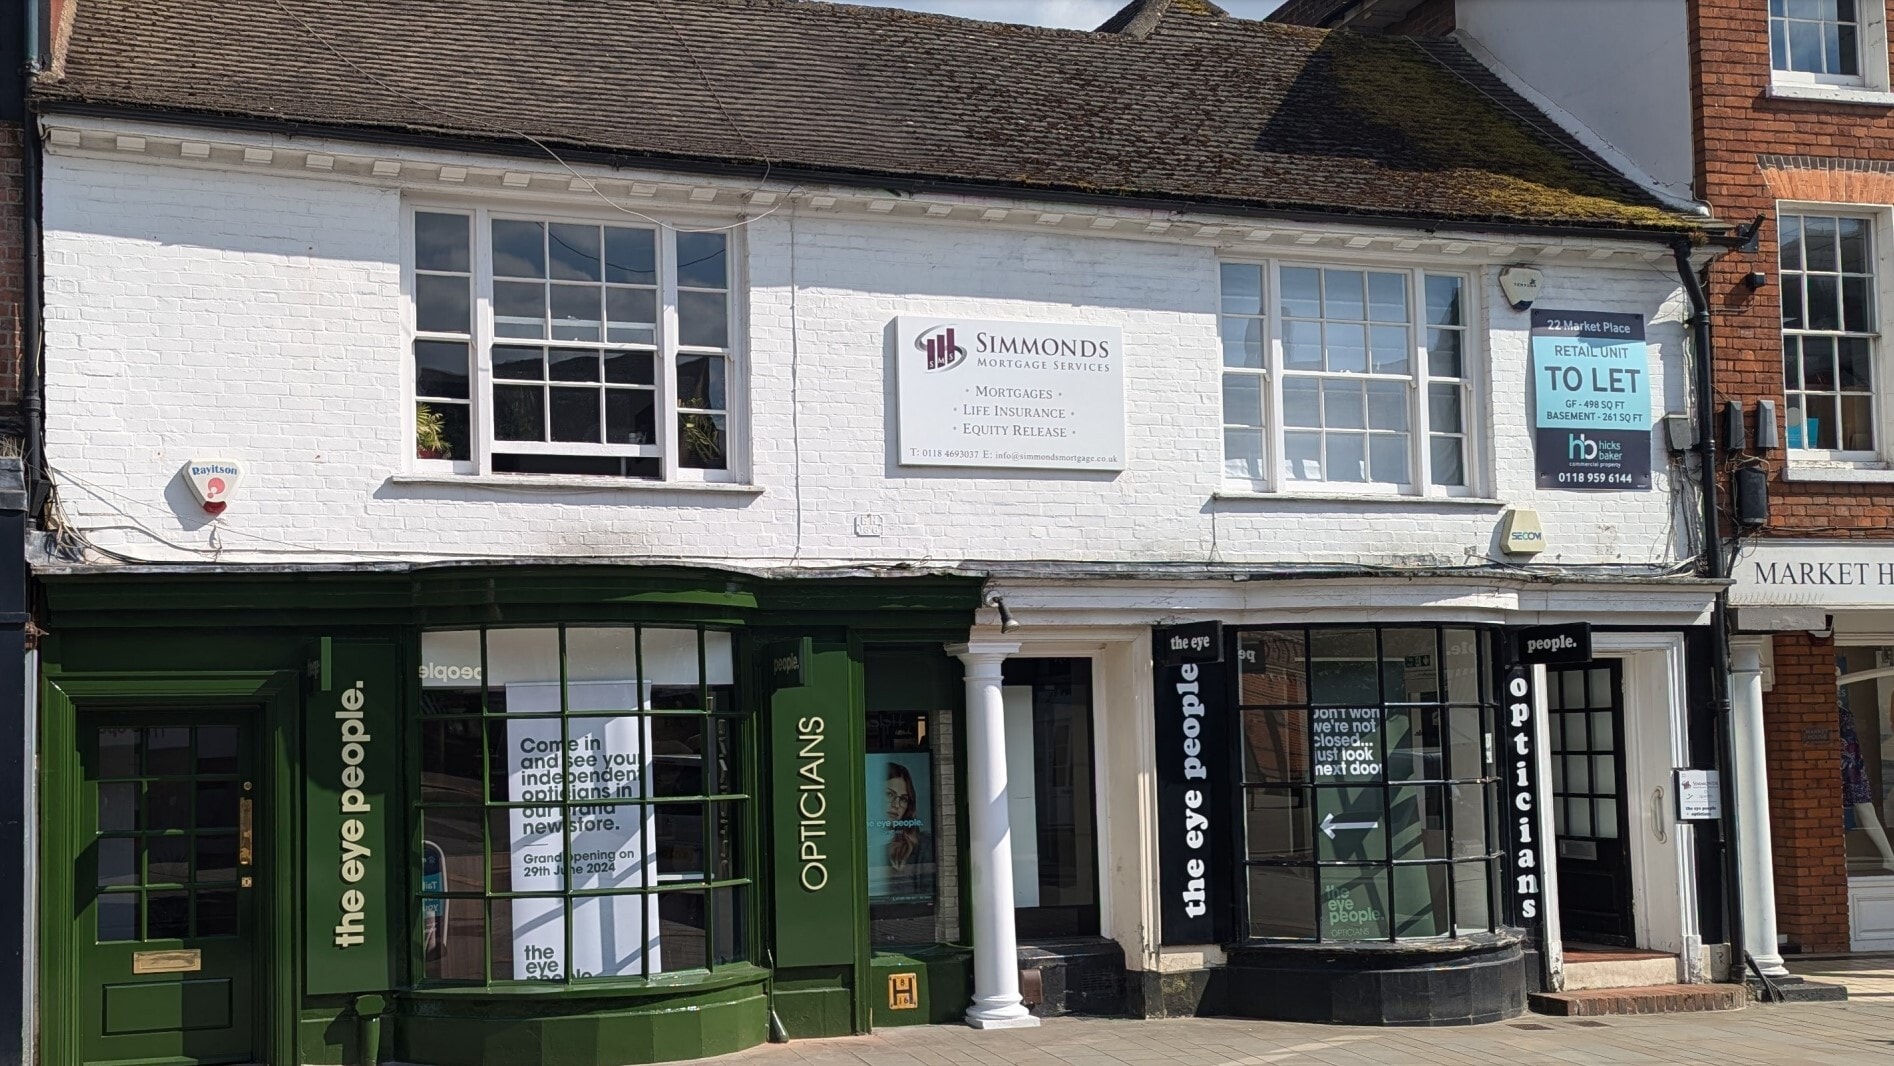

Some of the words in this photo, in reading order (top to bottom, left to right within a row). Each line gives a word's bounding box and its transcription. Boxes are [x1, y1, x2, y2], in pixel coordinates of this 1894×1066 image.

[1546, 319, 1561, 331] 22
[1563, 320, 1601, 332] Market
[1603, 321, 1631, 334] Place
[976, 332, 1109, 358] SIMMONDS
[1554, 345, 1598, 358] RETAIL
[1601, 346, 1628, 358] UNIT
[977, 358, 1047, 370] MORTGAGE
[1053, 360, 1110, 372] SERVICES
[1544, 366, 1583, 391] TO
[1591, 367, 1641, 393] LET
[975, 385, 1053, 399] MORTGAGES
[963, 404, 990, 416] LIFE
[994, 405, 1066, 418] INSURANCE
[1565, 400, 1577, 408] GF
[1583, 400, 1599, 409] 498
[1601, 401, 1613, 409] SQ
[1615, 401, 1625, 409] FT
[1546, 411, 1596, 420] BASEMENT
[1602, 412, 1617, 421] 261
[1619, 413, 1631, 422] SQ
[1632, 413, 1643, 422] FT
[962, 423, 1008, 436] EQUITY
[1013, 424, 1067, 438] RELEASE
[1599, 440, 1621, 450] hicks
[910, 447, 920, 457] T:
[922, 448, 942, 457] 0118
[944, 449, 979, 459] 4693037
[983, 449, 993, 459] E:
[1599, 451, 1622, 460] baker
[1558, 472, 1585, 483] 0118
[1587, 472, 1605, 483] 959
[1608, 473, 1632, 484] 6144
[1511, 531, 1542, 541] SECOM
[1754, 561, 1870, 585] MARKET
[1170, 635, 1188, 650] the
[1190, 636, 1210, 651] eye
[1527, 634, 1577, 653] people.
[1314, 719, 1349, 732] we're
[1353, 719, 1376, 732] not
[335, 680, 371, 812] people.
[520, 737, 579, 753] Come
[584, 735, 601, 751] in
[520, 753, 558, 770] and
[602, 753, 640, 769] you
[1342, 747, 1374, 761] look
[1315, 761, 1346, 776] next
[616, 783, 633, 798] in
[1509, 677, 1539, 918] opticians
[798, 716, 828, 890] OPTICIANS
[522, 807, 555, 818] our
[559, 805, 616, 817] rand
[523, 820, 563, 835] new
[568, 817, 620, 834] store.
[1184, 790, 1209, 849] eye
[341, 819, 371, 882] eye
[523, 851, 563, 864] Grand
[569, 849, 616, 865] pening
[619, 850, 634, 859] on
[523, 865, 551, 877] 29th
[586, 862, 616, 874] 2024
[1182, 859, 1207, 919] the
[1328, 899, 1354, 913] eye
[335, 889, 365, 947] the
[1329, 907, 1385, 926] people.
[524, 944, 555, 960] the
[525, 960, 559, 977] eye
